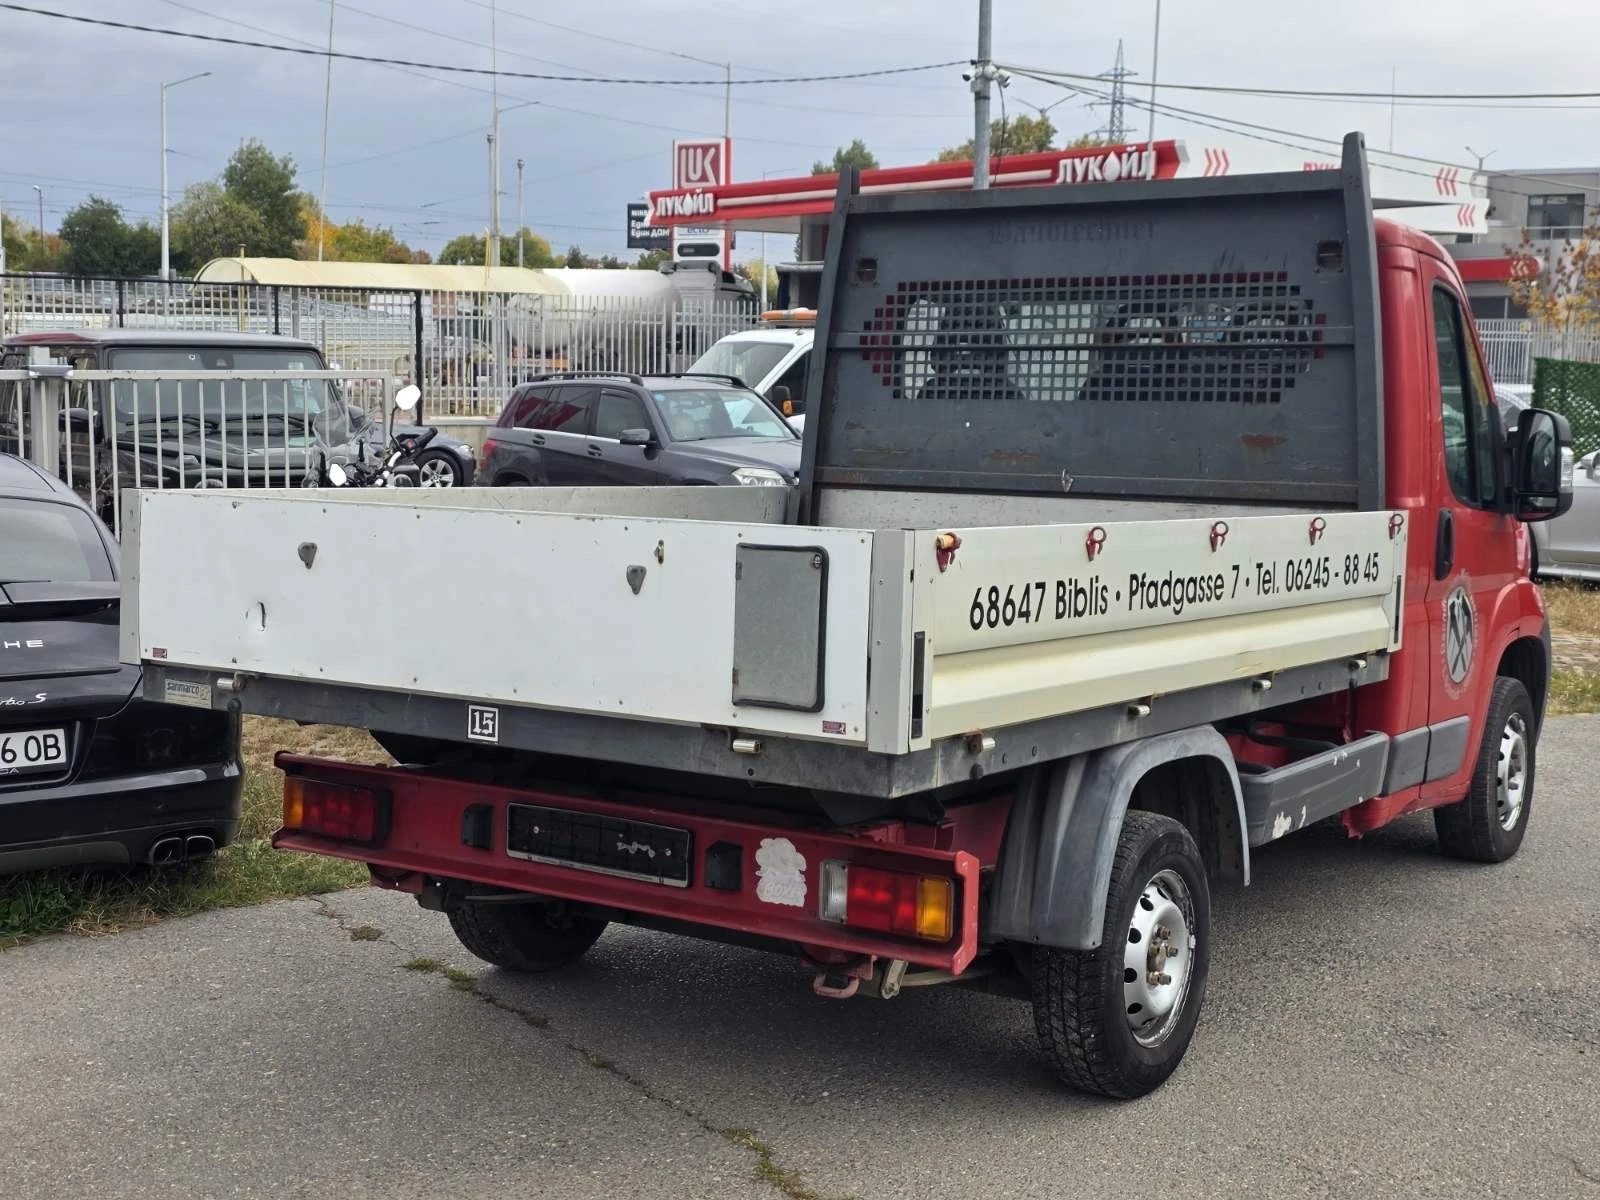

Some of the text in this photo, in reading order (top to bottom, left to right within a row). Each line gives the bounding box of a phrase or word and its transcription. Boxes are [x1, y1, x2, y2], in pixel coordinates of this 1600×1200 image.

[656, 188, 714, 216] ЛУКОЙЛ
[970, 582, 1046, 630] 68647
[1055, 575, 1108, 620] Biblis
[1128, 570, 1224, 615] Pfadgasse
[1231, 564, 1240, 599] 7
[1256, 561, 1279, 596] Tel.
[1363, 551, 1380, 582] 45
